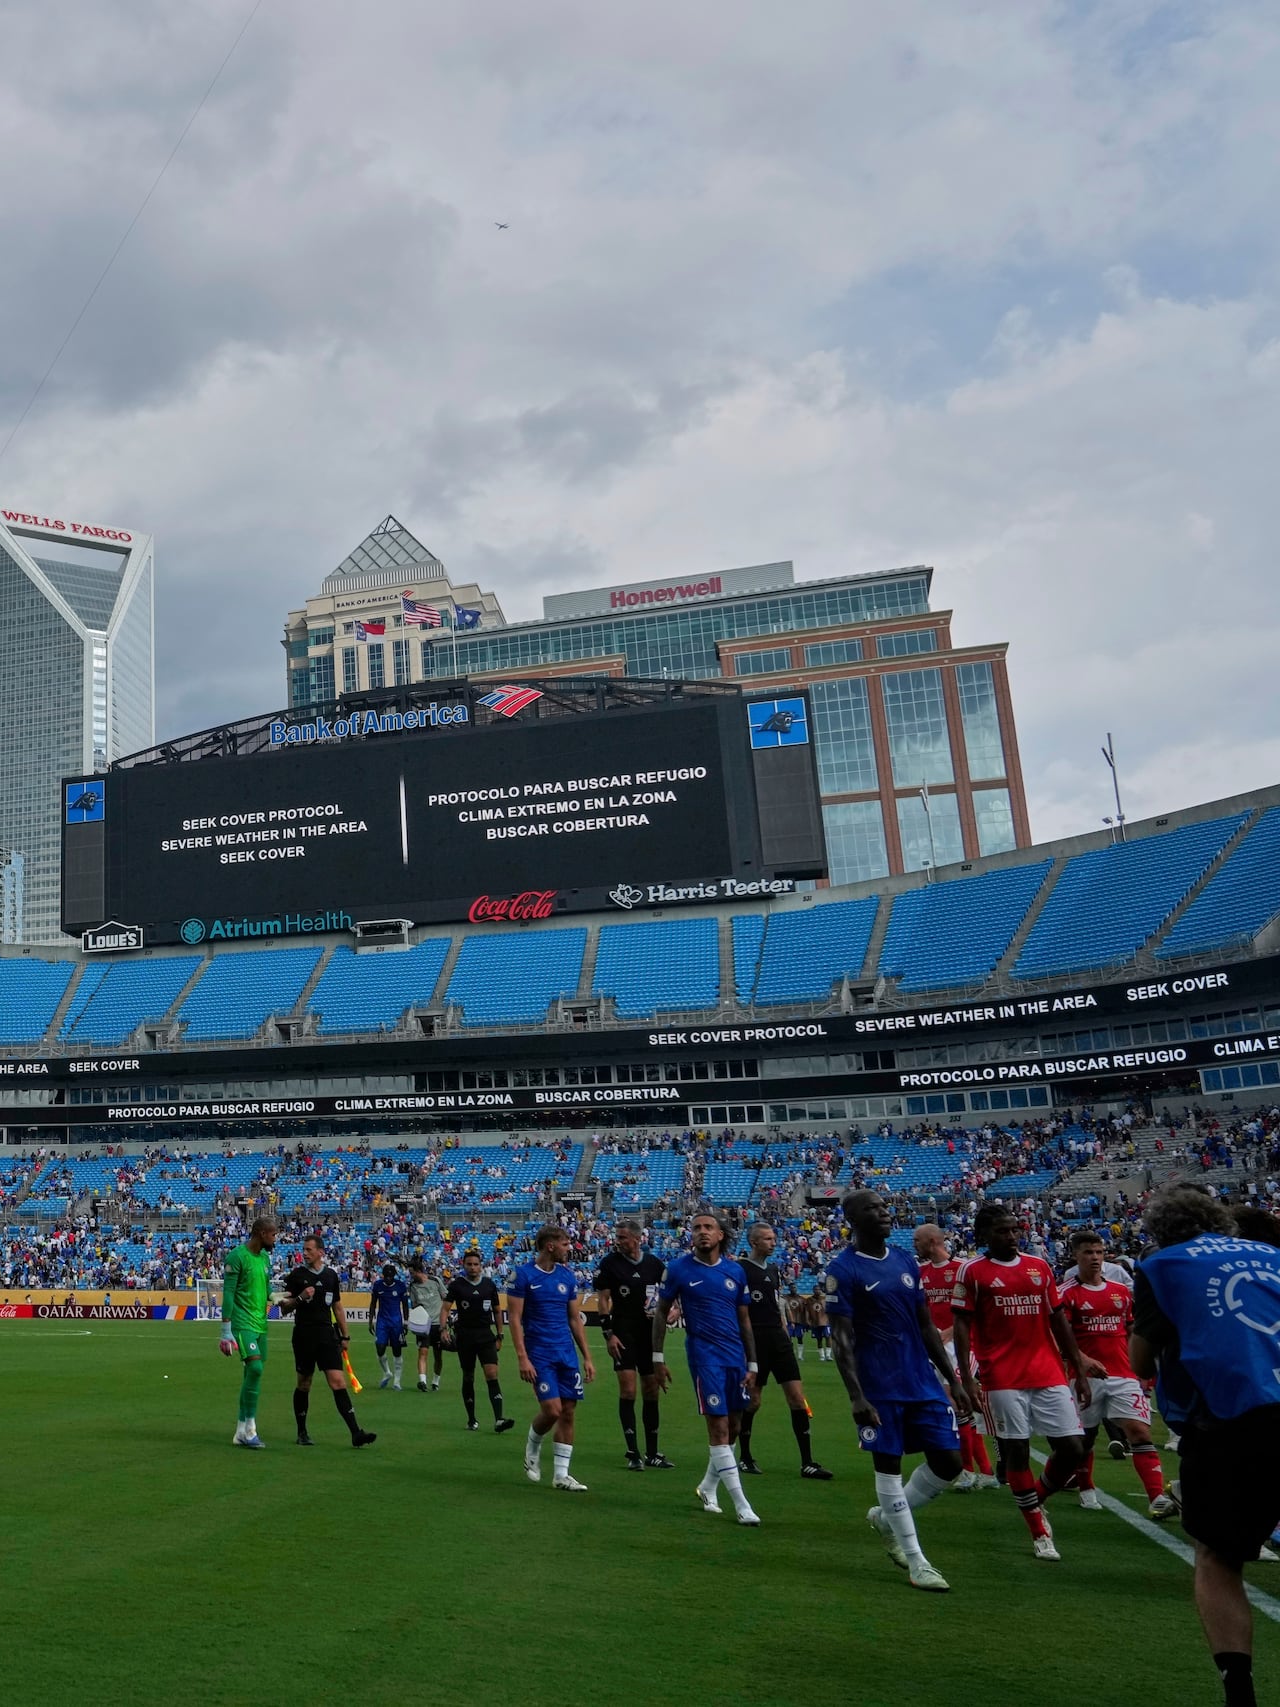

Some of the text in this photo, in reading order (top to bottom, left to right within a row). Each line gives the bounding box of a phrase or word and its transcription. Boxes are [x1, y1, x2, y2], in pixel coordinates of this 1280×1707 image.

[0, 509, 133, 543] WELLS FARGO
[336, 600, 356, 609] BANK
[366, 593, 399, 604] AMERICA
[609, 576, 723, 608] Honeywell
[269, 702, 470, 746] Bank of America
[429, 767, 706, 806] PROTOCOLO PARA BUSCAR REFUGIO
[183, 804, 343, 830] SEEK COVER PROTOCOL
[459, 791, 677, 822] CLIMA EXTREMO EN LA ZONA
[162, 821, 367, 851] SEVERE WEATHER IN THE AREA
[487, 814, 649, 839] BUSCAR COBERTURA
[220, 846, 305, 864] SEEK COVER
[647, 878, 794, 903] Harris Teeter
[209, 910, 353, 940] Atrium Health
[88, 931, 137, 949] LOWE'S
[1127, 973, 1228, 1000] SEEK COVER
[855, 995, 1097, 1032] SEVERE WEATHER IN THE AREA
[649, 1025, 827, 1045] SEEK COVER PROTOCOL
[1214, 1036, 1280, 1056] CLIMA E
[17, 1064, 48, 1073] AREA
[69, 1060, 139, 1072] SEEK COVER
[900, 1049, 1186, 1086] PROTOCOLO PARA BUSCAR REFUGIO
[335, 1094, 513, 1110] CLIMA EXTREMO EN LA ZONA
[536, 1087, 680, 1103] BUSCAR COBERTURA
[109, 1100, 314, 1118] PROTOCOLO PARA BUSCAR REFUGIO
[1186, 1244, 1275, 1257] PHOTO
[1206, 1261, 1280, 1317] CLUB WORL
[38, 1305, 148, 1319] QATAR AIRWAYS
[199, 1306, 223, 1319] VIS
[1004, 1304, 1040, 1316] FLY BETTER
